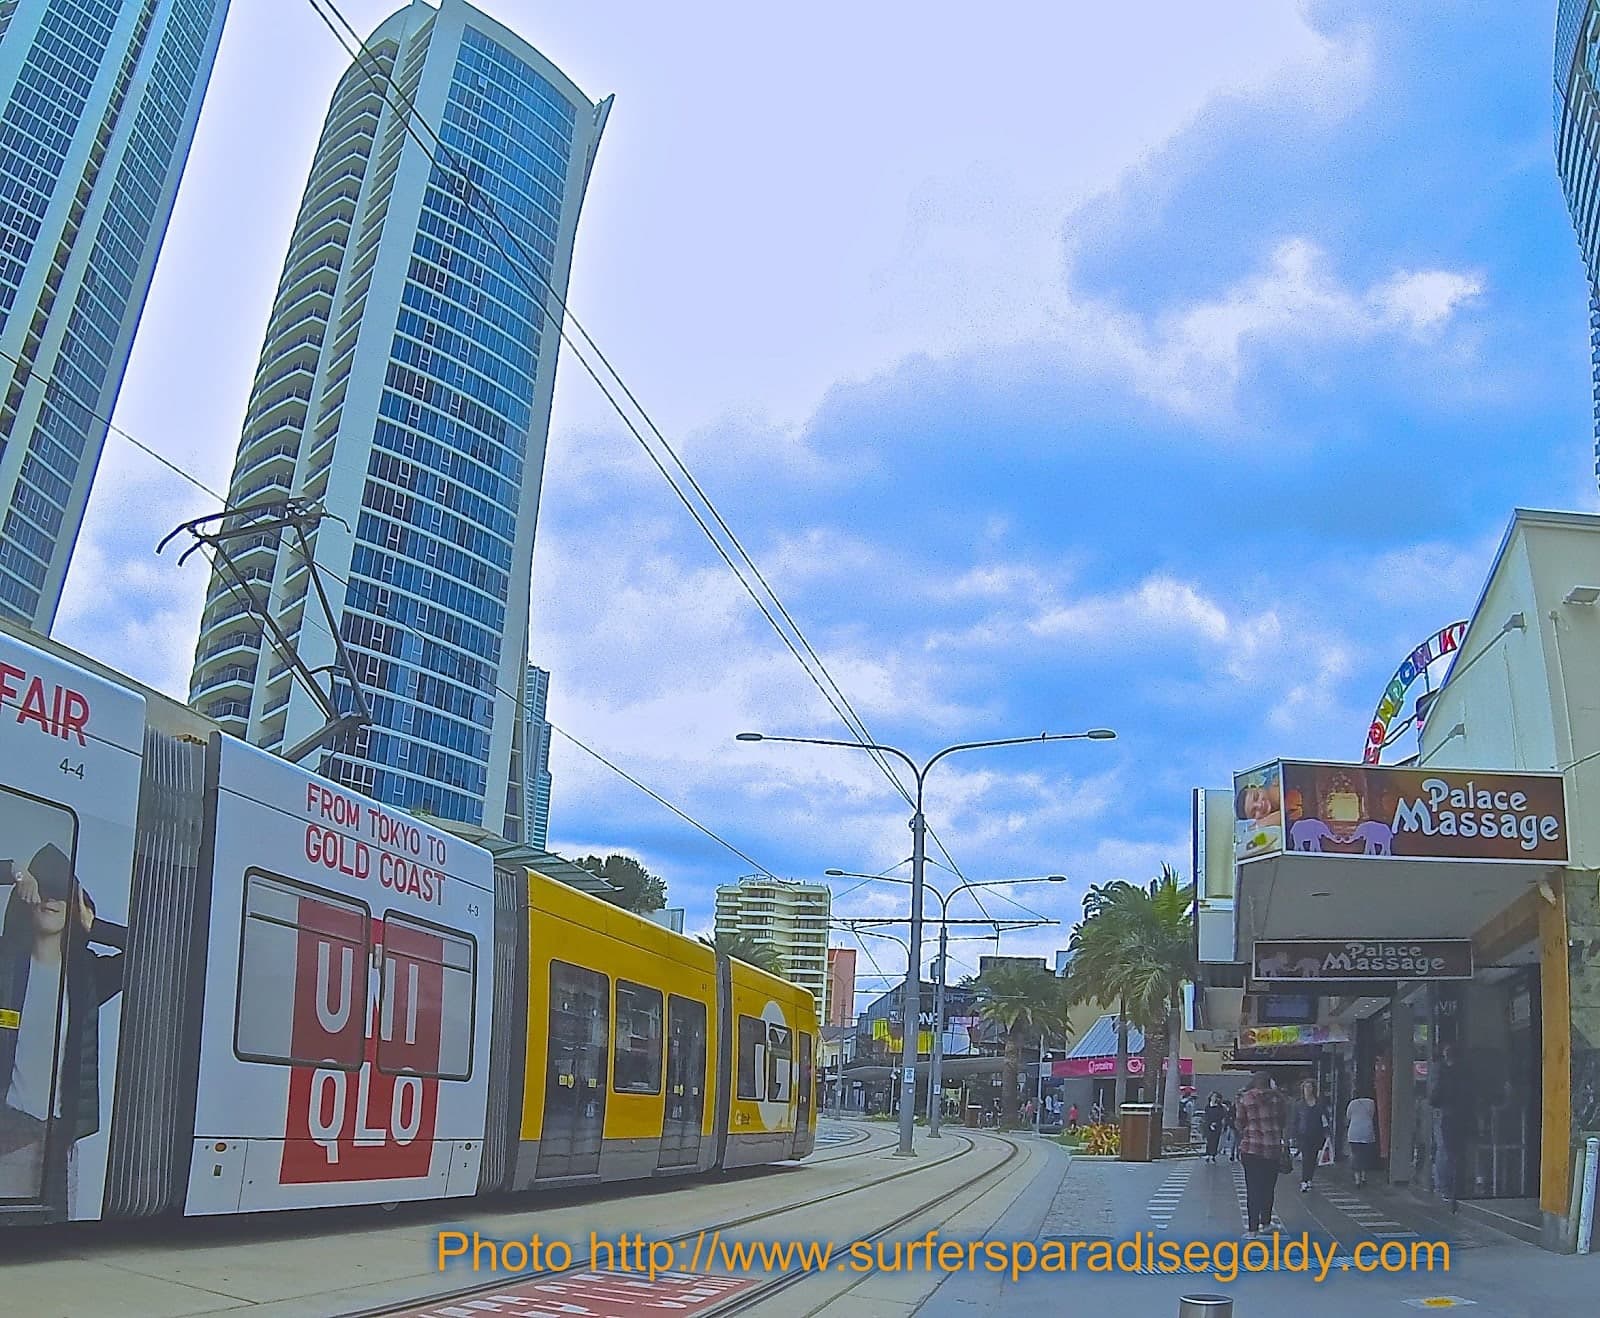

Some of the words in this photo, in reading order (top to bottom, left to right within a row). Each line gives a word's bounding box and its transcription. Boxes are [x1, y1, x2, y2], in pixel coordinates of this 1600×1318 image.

[0, 660, 90, 748] FAIR
[59, 757, 85, 781] 4-4
[1421, 778, 1527, 813] Palace
[306, 782, 361, 832] FROM
[367, 808, 421, 856] TOKYO
[427, 834, 447, 866] TO
[1391, 797, 1560, 851] Massage
[305, 824, 371, 880] GOLD
[379, 852, 447, 906] COAST
[467, 903, 480, 918] 4-3
[1321, 952, 1447, 975] Massage
[1344, 942, 1422, 961] Palace
[315, 940, 420, 1045] UNI
[307, 1057, 424, 1165] QLO
